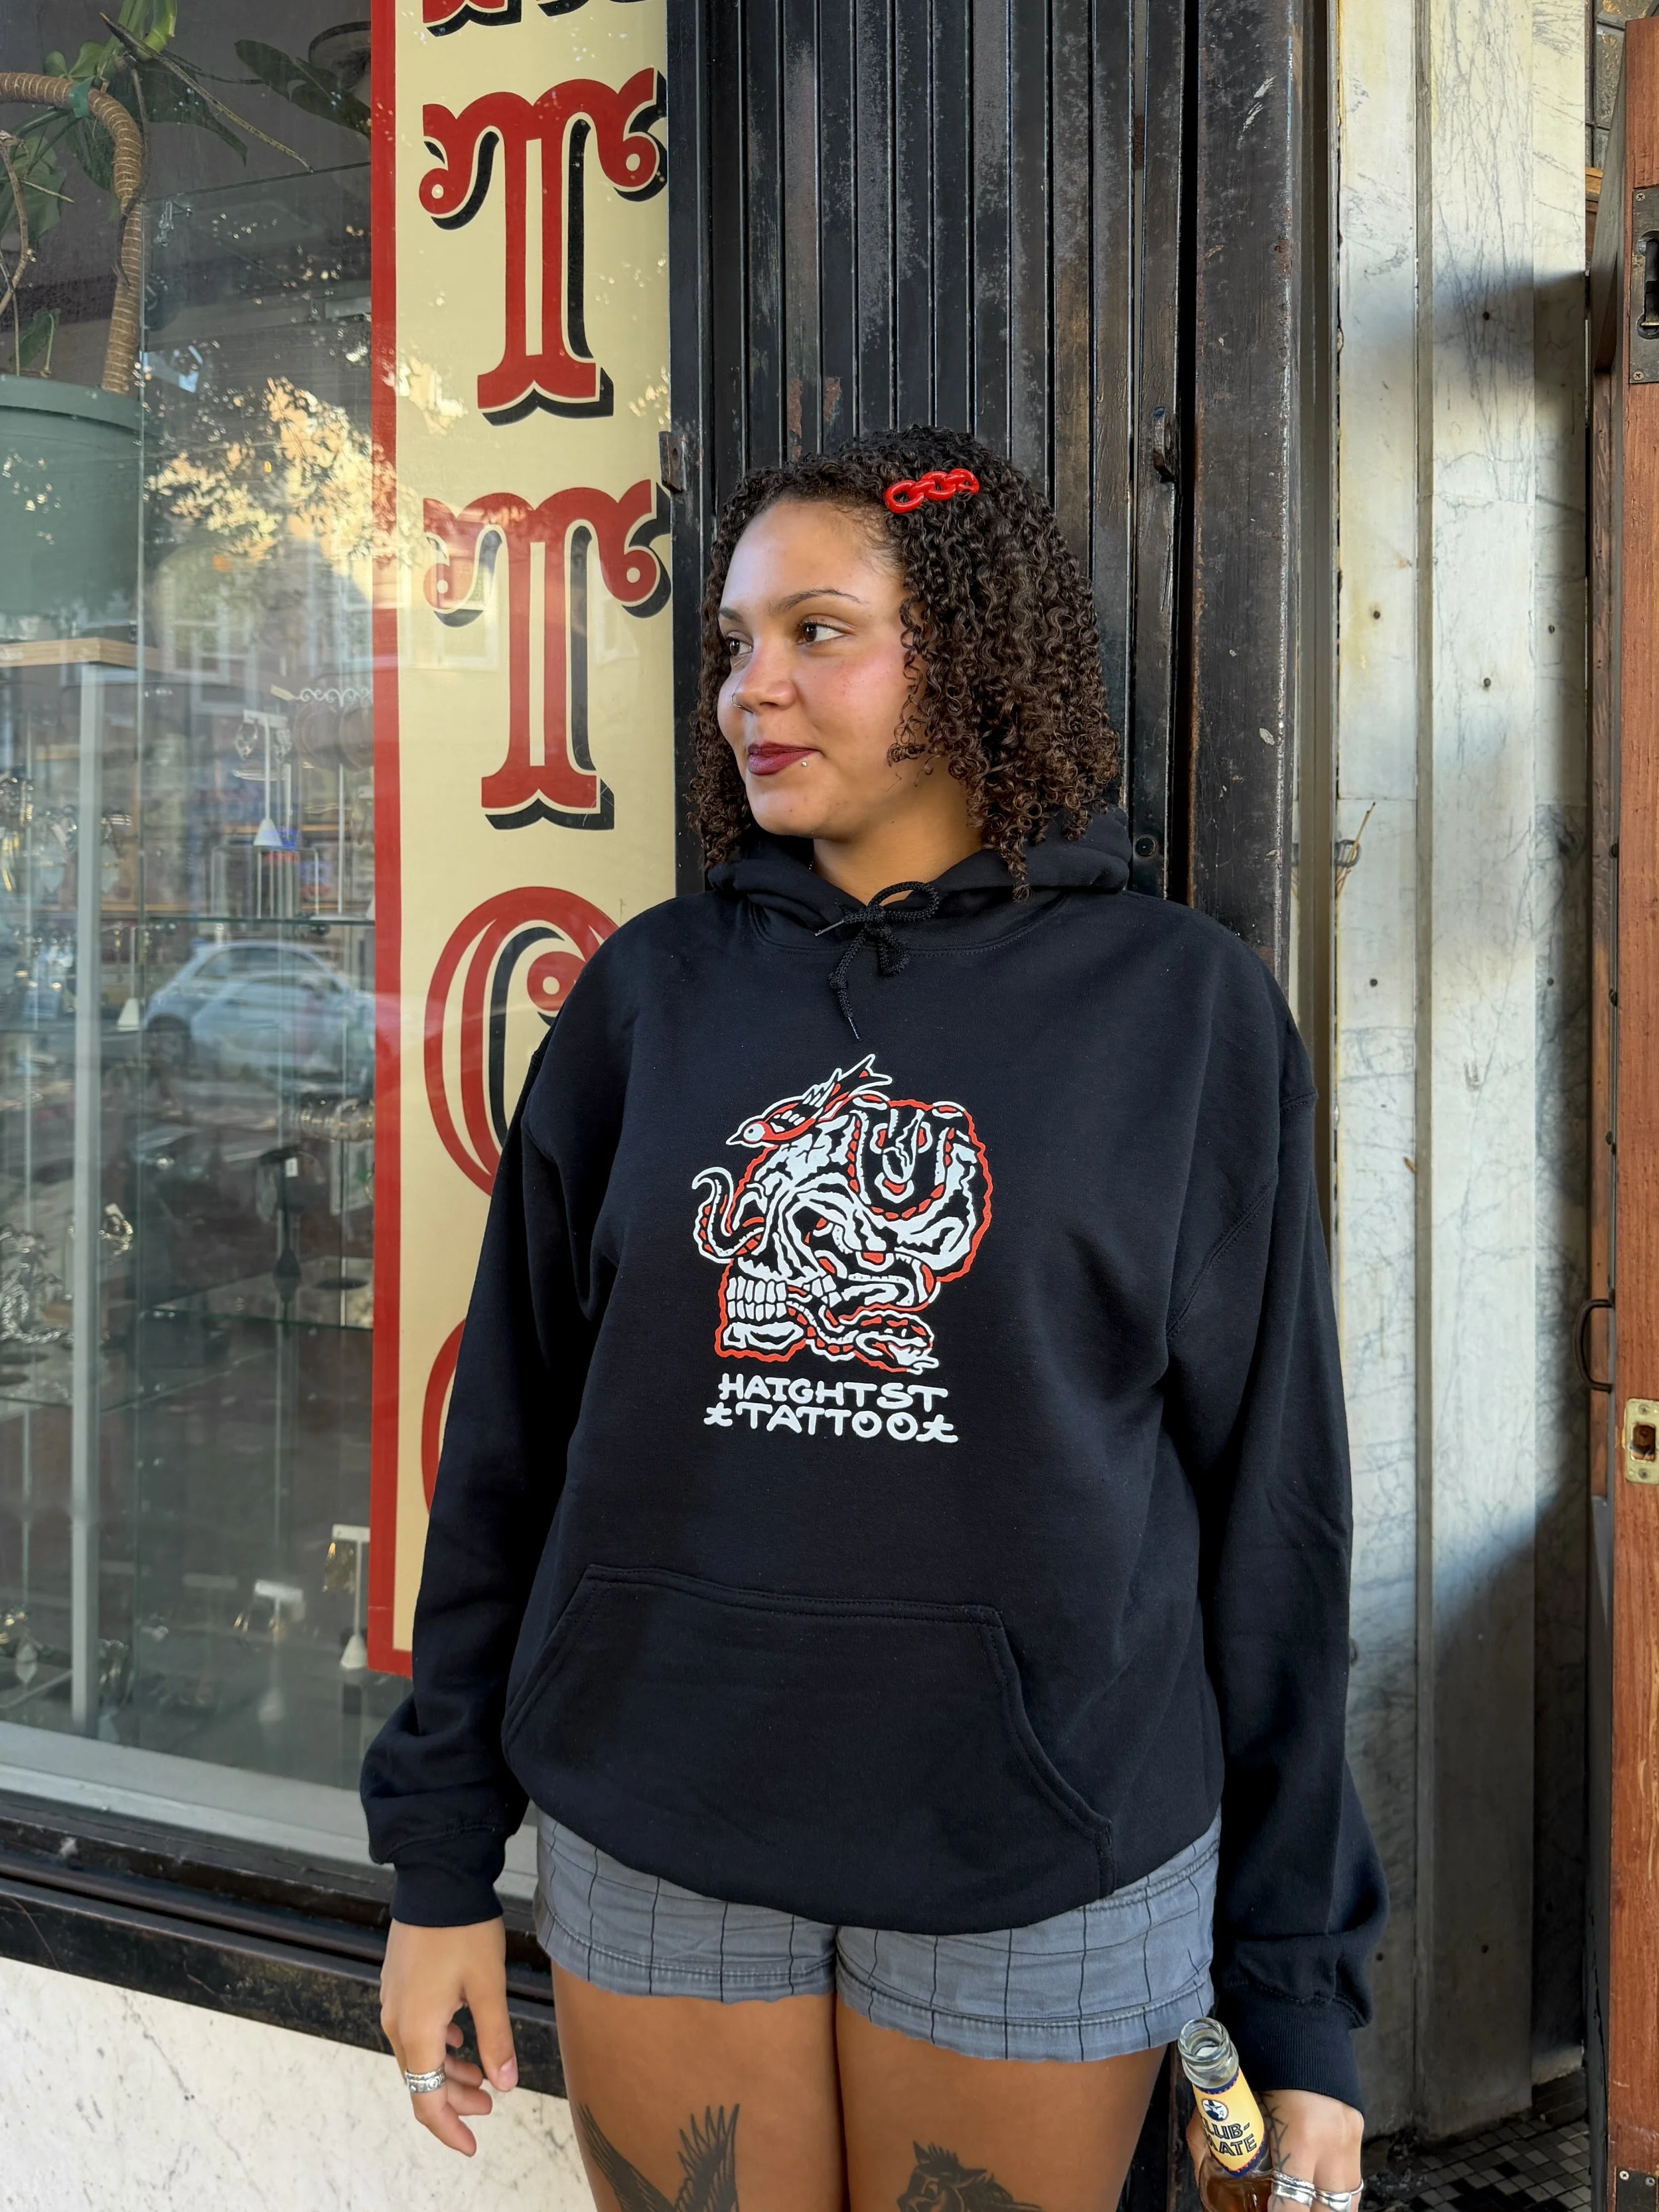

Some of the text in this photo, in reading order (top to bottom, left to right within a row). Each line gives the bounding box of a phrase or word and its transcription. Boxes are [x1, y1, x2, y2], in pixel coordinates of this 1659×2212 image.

[718, 1373, 948, 1412] HAIGHT ST
[735, 1402, 918, 1441] TATTOO
